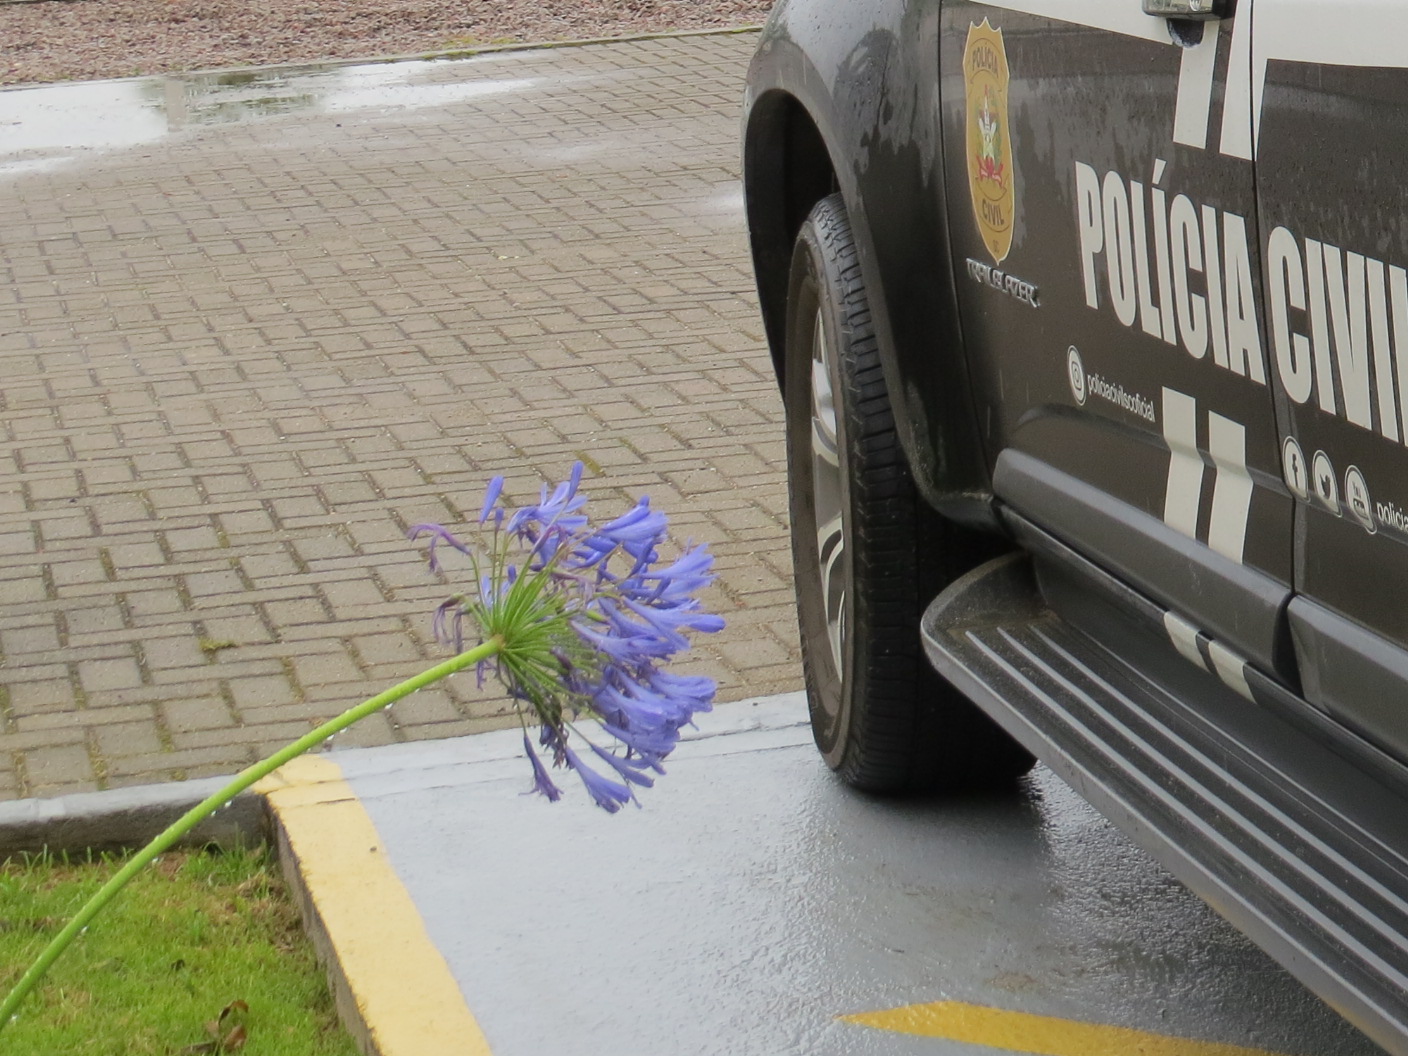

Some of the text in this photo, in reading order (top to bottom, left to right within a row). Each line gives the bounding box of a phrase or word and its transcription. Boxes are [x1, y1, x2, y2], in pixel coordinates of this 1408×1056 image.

[982, 199, 1005, 226] CIVIL
[966, 258, 1041, 308] TRAILBLAZER
[1075, 158, 1267, 385] POLÍCIA
[1087, 373, 1156, 423] policiacivilscoficial
